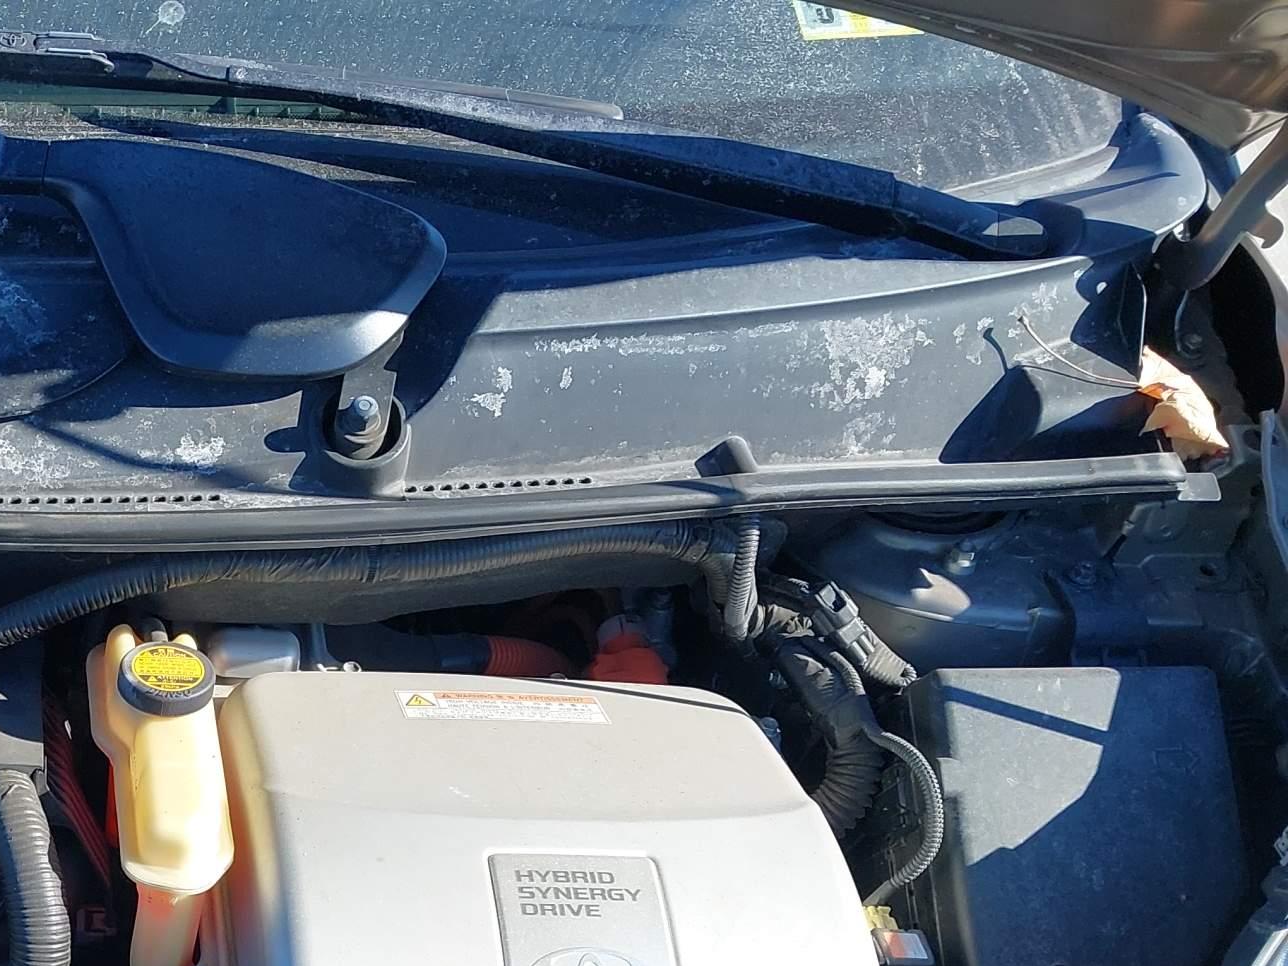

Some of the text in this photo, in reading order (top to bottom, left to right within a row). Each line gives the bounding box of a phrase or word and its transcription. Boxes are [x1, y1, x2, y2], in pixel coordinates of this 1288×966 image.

[514, 870, 616, 884] HYBRID
[517, 886, 641, 902] SYNERGY
[519, 903, 602, 918] DRIVE
